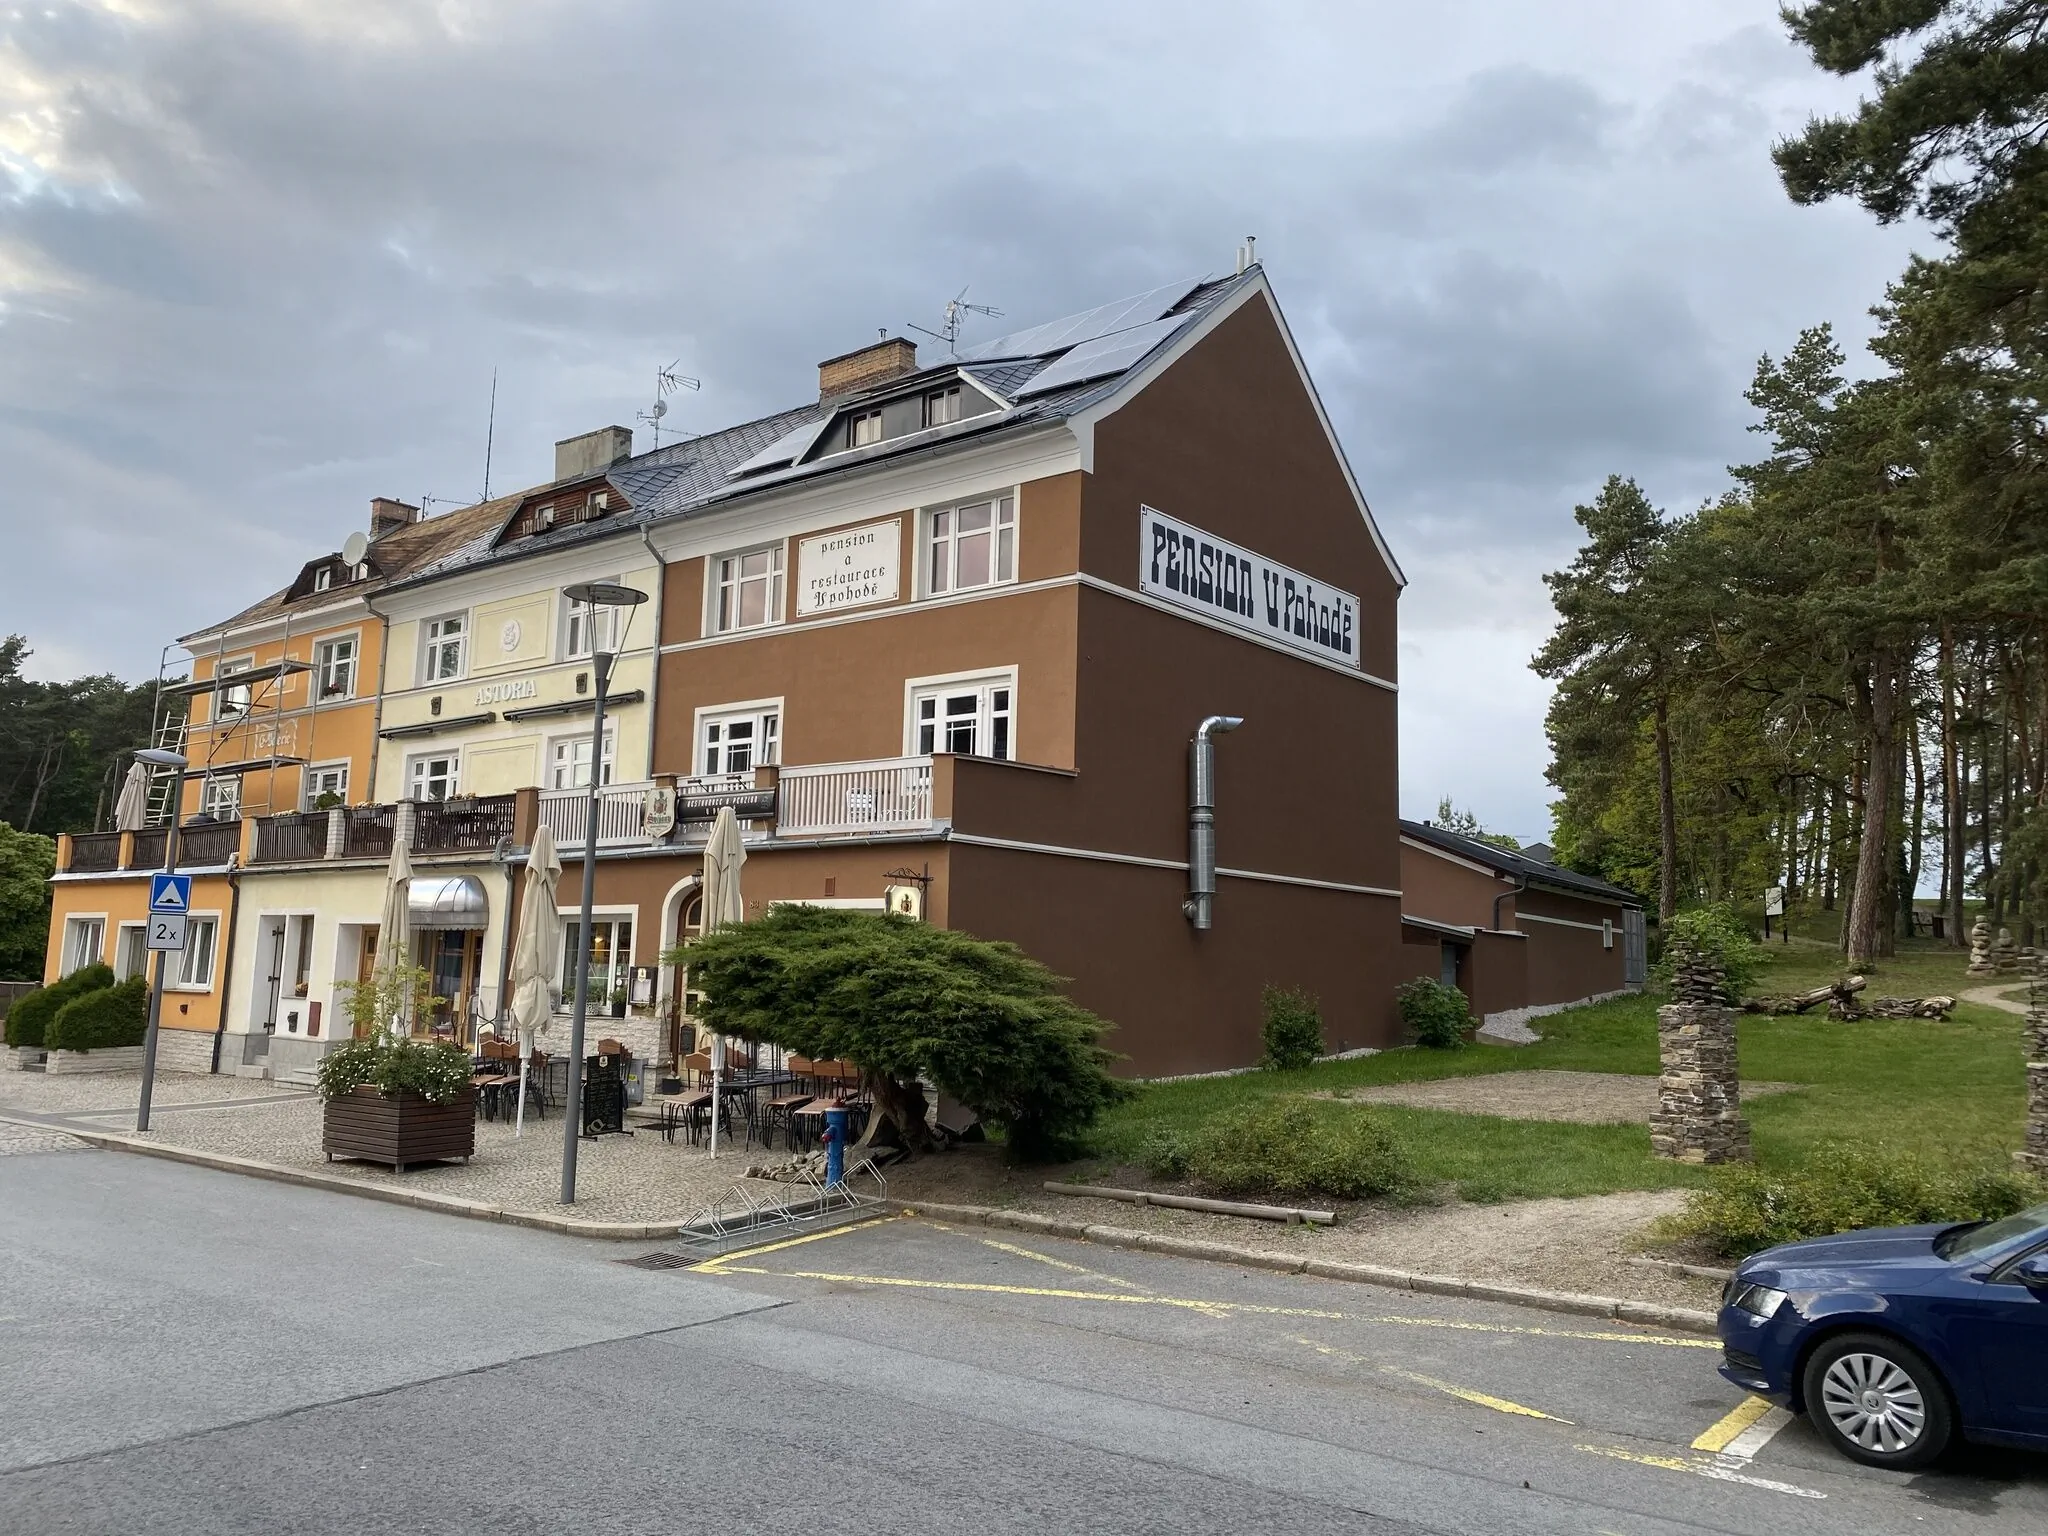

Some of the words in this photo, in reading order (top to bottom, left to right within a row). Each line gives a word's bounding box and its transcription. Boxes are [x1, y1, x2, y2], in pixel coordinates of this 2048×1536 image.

[821, 533, 875, 560] pension
[844, 555, 851, 566] a
[811, 566, 885, 590] restaurace
[474, 679, 537, 706] ASTORIA
